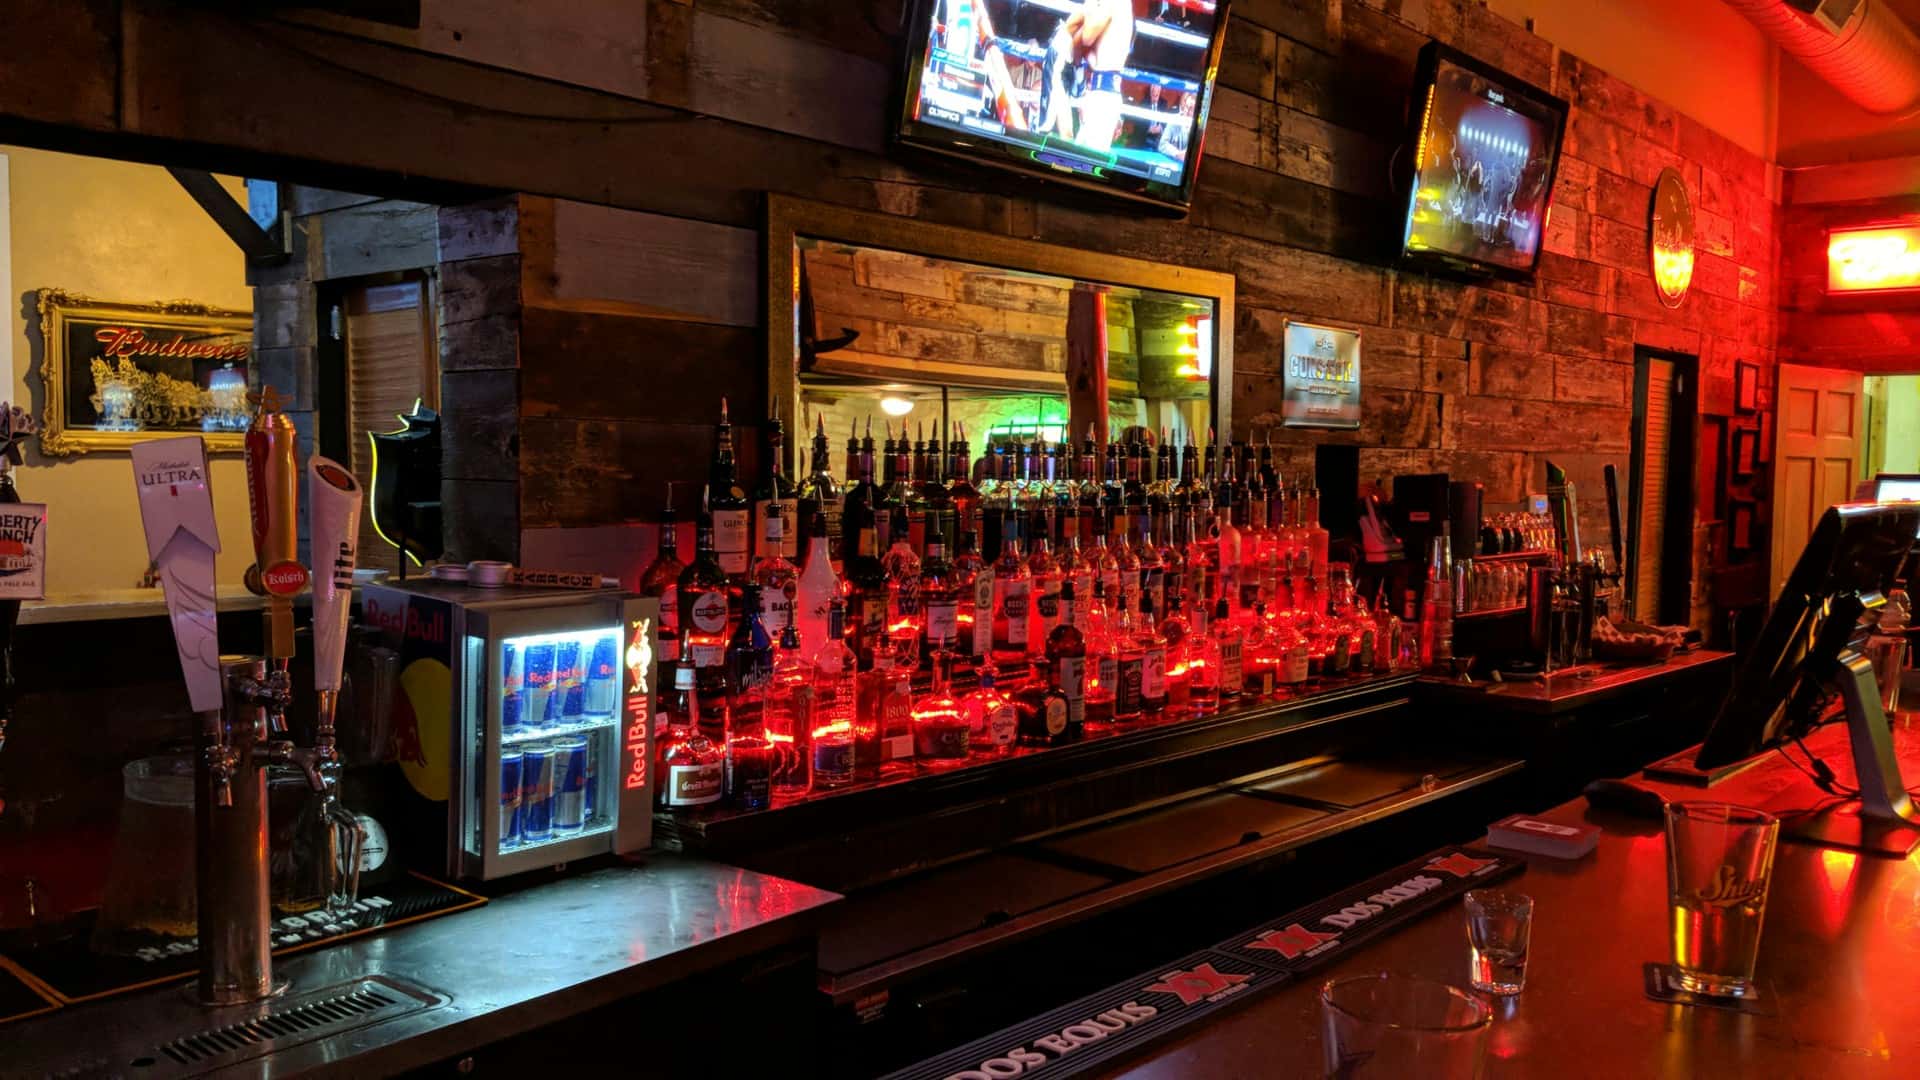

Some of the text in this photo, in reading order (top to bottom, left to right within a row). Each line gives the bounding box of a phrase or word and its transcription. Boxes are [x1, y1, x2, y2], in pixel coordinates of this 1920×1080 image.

[95, 326, 250, 360] Budweise
[142, 470, 201, 486] ULTRA
[626, 695, 649, 790] Red Bull
[1319, 900, 1385, 929] DOS
[1366, 874, 1443, 908] EQUIS
[1032, 1000, 1159, 1057] EQUIS
